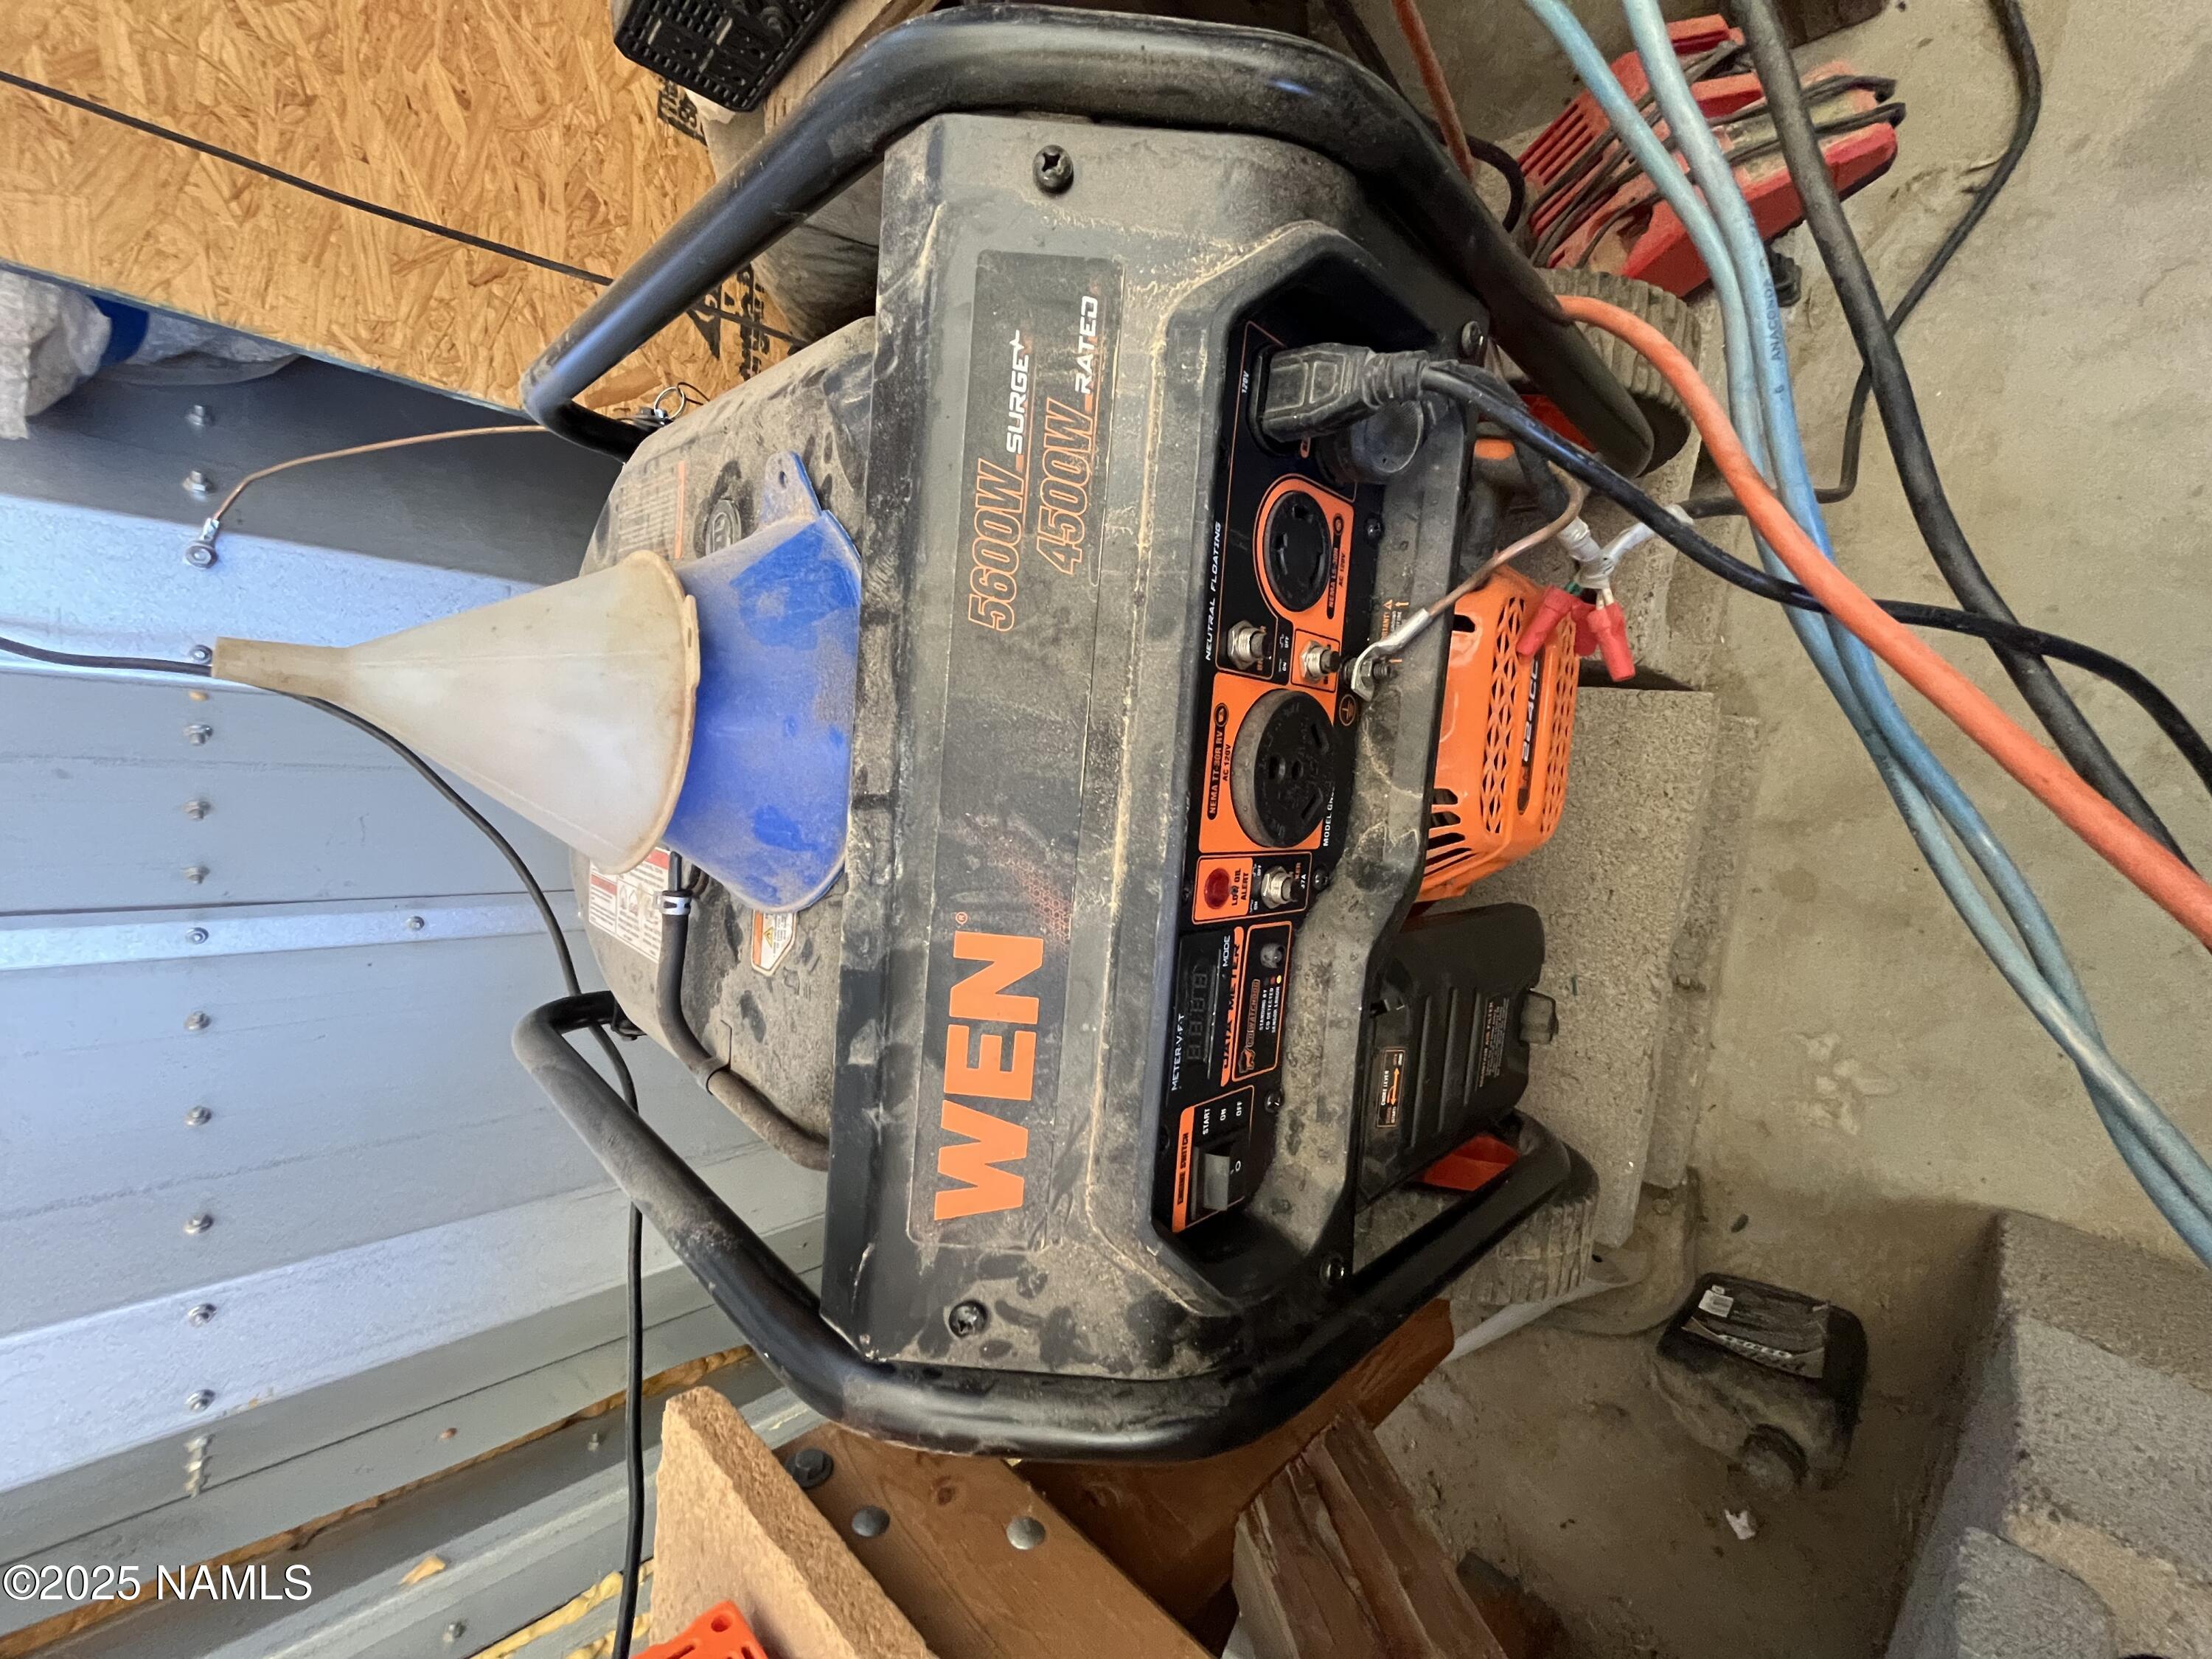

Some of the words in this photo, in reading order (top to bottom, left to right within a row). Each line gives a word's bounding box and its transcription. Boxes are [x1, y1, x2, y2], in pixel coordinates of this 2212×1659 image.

[1764, 279, 1781, 361] ANACONDA
[1036, 397, 1093, 574] 4500W
[1075, 296, 1098, 394] RATED
[968, 458, 1025, 631] 5600W
[1006, 337, 1029, 454] SURGE
[1206, 597, 1215, 661] NEUTRAL
[1211, 521, 1221, 591] FLOATING
[1339, 575, 1343, 587] AC
[1283, 662, 1287, 671] ON
[1521, 659, 1538, 762] 224CC
[1216, 731, 1222, 744] RV
[1212, 748, 1222, 781] TT-30R
[1222, 770, 1228, 781] AC
[1209, 785, 1218, 814] NEMA
[1323, 813, 1332, 846] MODEL
[1241, 872, 1249, 900] ALERT
[1222, 936, 1231, 966] MODE
[934, 931, 1043, 1220] WEN
[1220, 1109, 1226, 1121] ON
[1180, 1133, 1189, 1168] SWITCH
